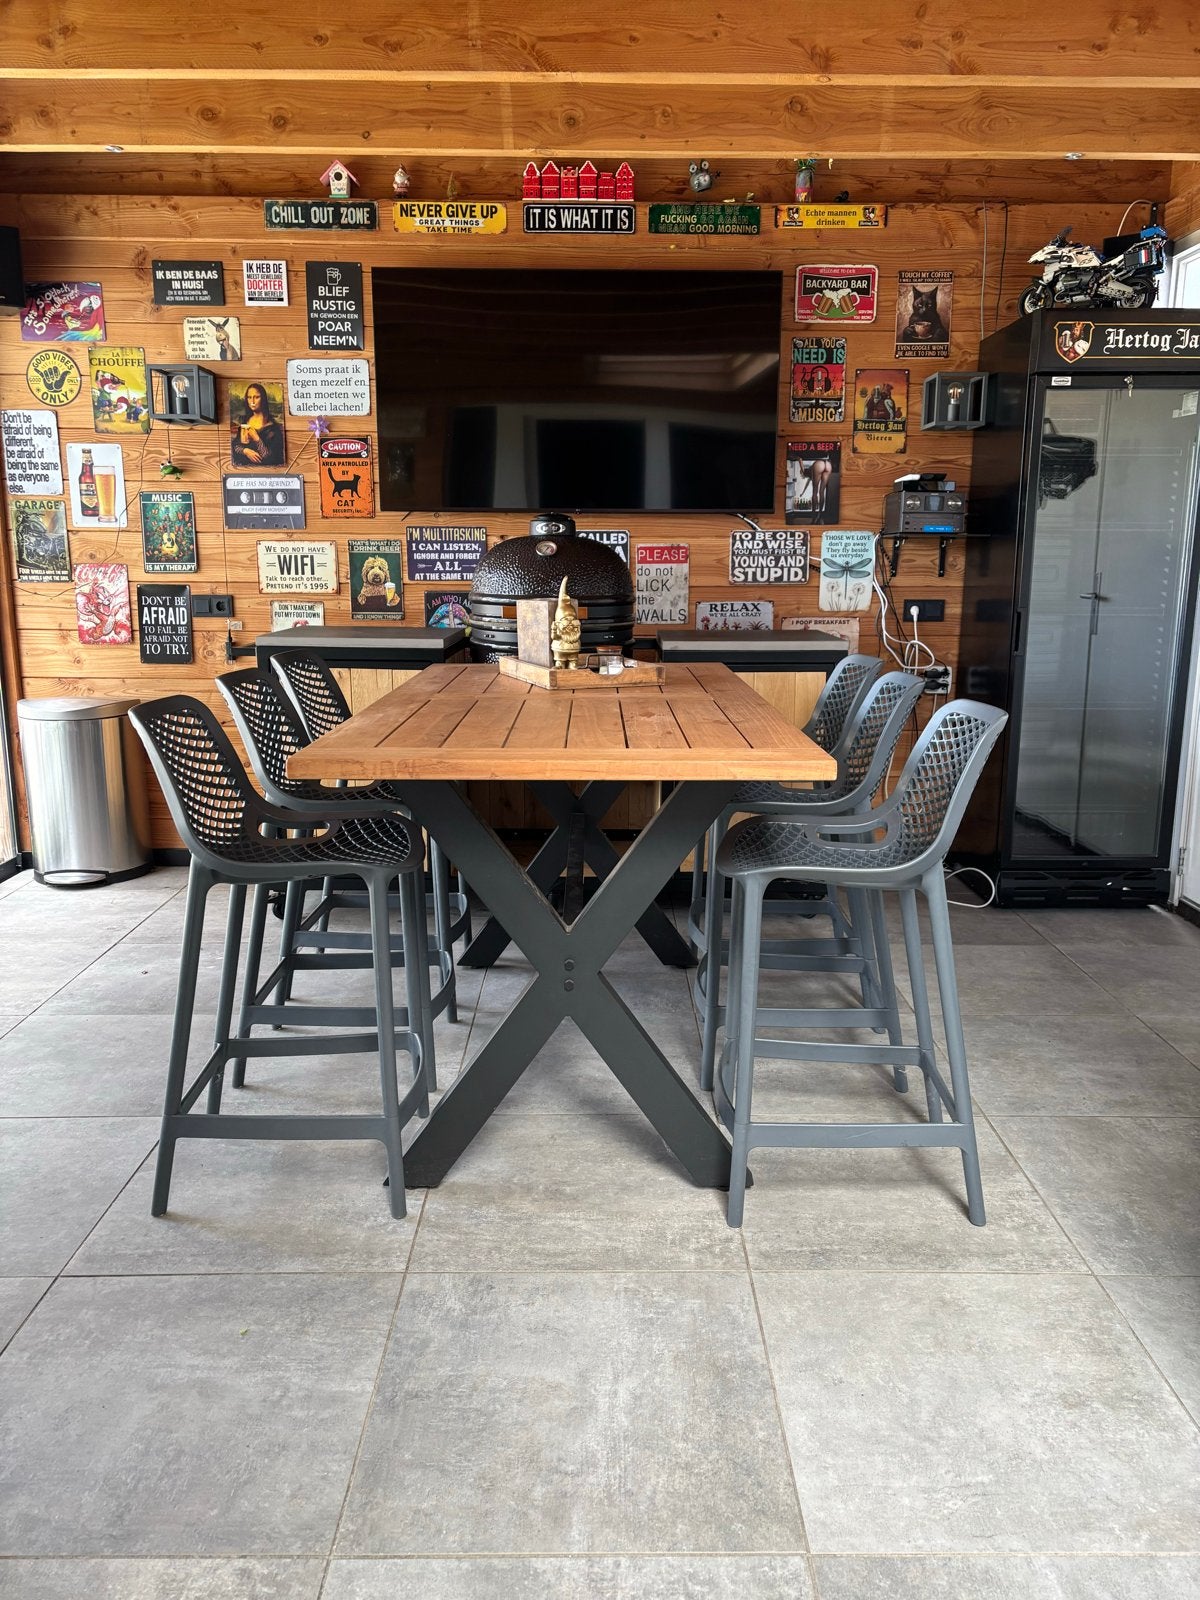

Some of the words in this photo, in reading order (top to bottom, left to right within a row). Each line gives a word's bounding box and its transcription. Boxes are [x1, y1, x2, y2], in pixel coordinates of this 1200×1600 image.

[272, 206, 305, 223] CHILL
[311, 207, 334, 223] OUT
[341, 208, 370, 224] ZONE
[400, 204, 442, 217] NEVER
[446, 204, 476, 218] GIVE
[481, 205, 497, 218] UP
[530, 209, 541, 228] IT
[545, 209, 556, 228] IS
[561, 209, 598, 228] WHAT
[602, 209, 613, 228] IT
[618, 210, 628, 229] IS
[660, 215, 697, 223] FUCKING
[718, 225, 757, 233] MORNING
[246, 263, 254, 273] IK
[256, 263, 271, 273] HEB
[273, 264, 282, 273] DE
[156, 271, 164, 279] IK
[166, 271, 182, 279] BEN
[183, 271, 194, 279] DE
[195, 271, 218, 279] BAAS
[172, 280, 180, 289] IN
[182, 280, 203, 289] HUIS!
[247, 280, 283, 290] DOCHTER
[806, 280, 848, 288] BACKYARD
[851, 280, 867, 288] BAR
[318, 286, 349, 296] BLIEF
[313, 300, 355, 310] RUSTIG
[318, 321, 351, 332] POAR
[314, 335, 357, 346] NEEM'N
[804, 338, 817, 347] ALL
[822, 338, 835, 348] YOU
[1104, 328, 1172, 354] Hertog
[794, 349, 826, 363] NEED
[833, 349, 844, 363] IS
[32, 353, 50, 368] GOOD
[52, 353, 74, 370] VIBES
[90, 358, 143, 366] CHOUFFE
[296, 365, 322, 373] Soms
[324, 366, 349, 375] praat
[352, 365, 360, 373] ik
[292, 379, 317, 388] tegen
[321, 377, 353, 386] mezelf
[42, 391, 69, 403] ONLY
[297, 402, 327, 411] allebei
[330, 403, 364, 411] lachen!
[3, 413, 22, 423] Don't
[23, 413, 32, 423] be
[798, 408, 835, 421] MUSIC
[857, 421, 885, 431] Hertog
[33, 425, 51, 438] being
[6, 447, 15, 458] be
[17, 448, 36, 458] afraid
[7, 459, 26, 472] being
[28, 460, 39, 470] the
[18, 474, 49, 484] everyone
[152, 494, 182, 502] MUSIC
[15, 501, 60, 510] GARAGE
[407, 528, 420, 540] I'M
[423, 528, 486, 540] MULTITASKING
[444, 543, 481, 552] LISTEN,
[733, 540, 763, 549] AND
[766, 541, 806, 550] WISE,
[638, 549, 686, 560] PLEASE
[277, 555, 315, 575] WIFI
[434, 562, 462, 570] ALL
[733, 556, 775, 567] YOUNG
[778, 556, 804, 567] AND
[637, 565, 650, 576] do
[656, 566, 673, 576] not
[733, 568, 805, 582] STUPID.
[637, 579, 670, 591] LICK
[142, 596, 171, 606] DON'T
[175, 596, 186, 606] BE
[637, 595, 655, 605] the
[709, 603, 761, 612] RELAX
[142, 607, 187, 625] AFRAID
[637, 609, 686, 621] WALLS
[144, 644, 160, 654] TO
[163, 644, 189, 655] TRY.
